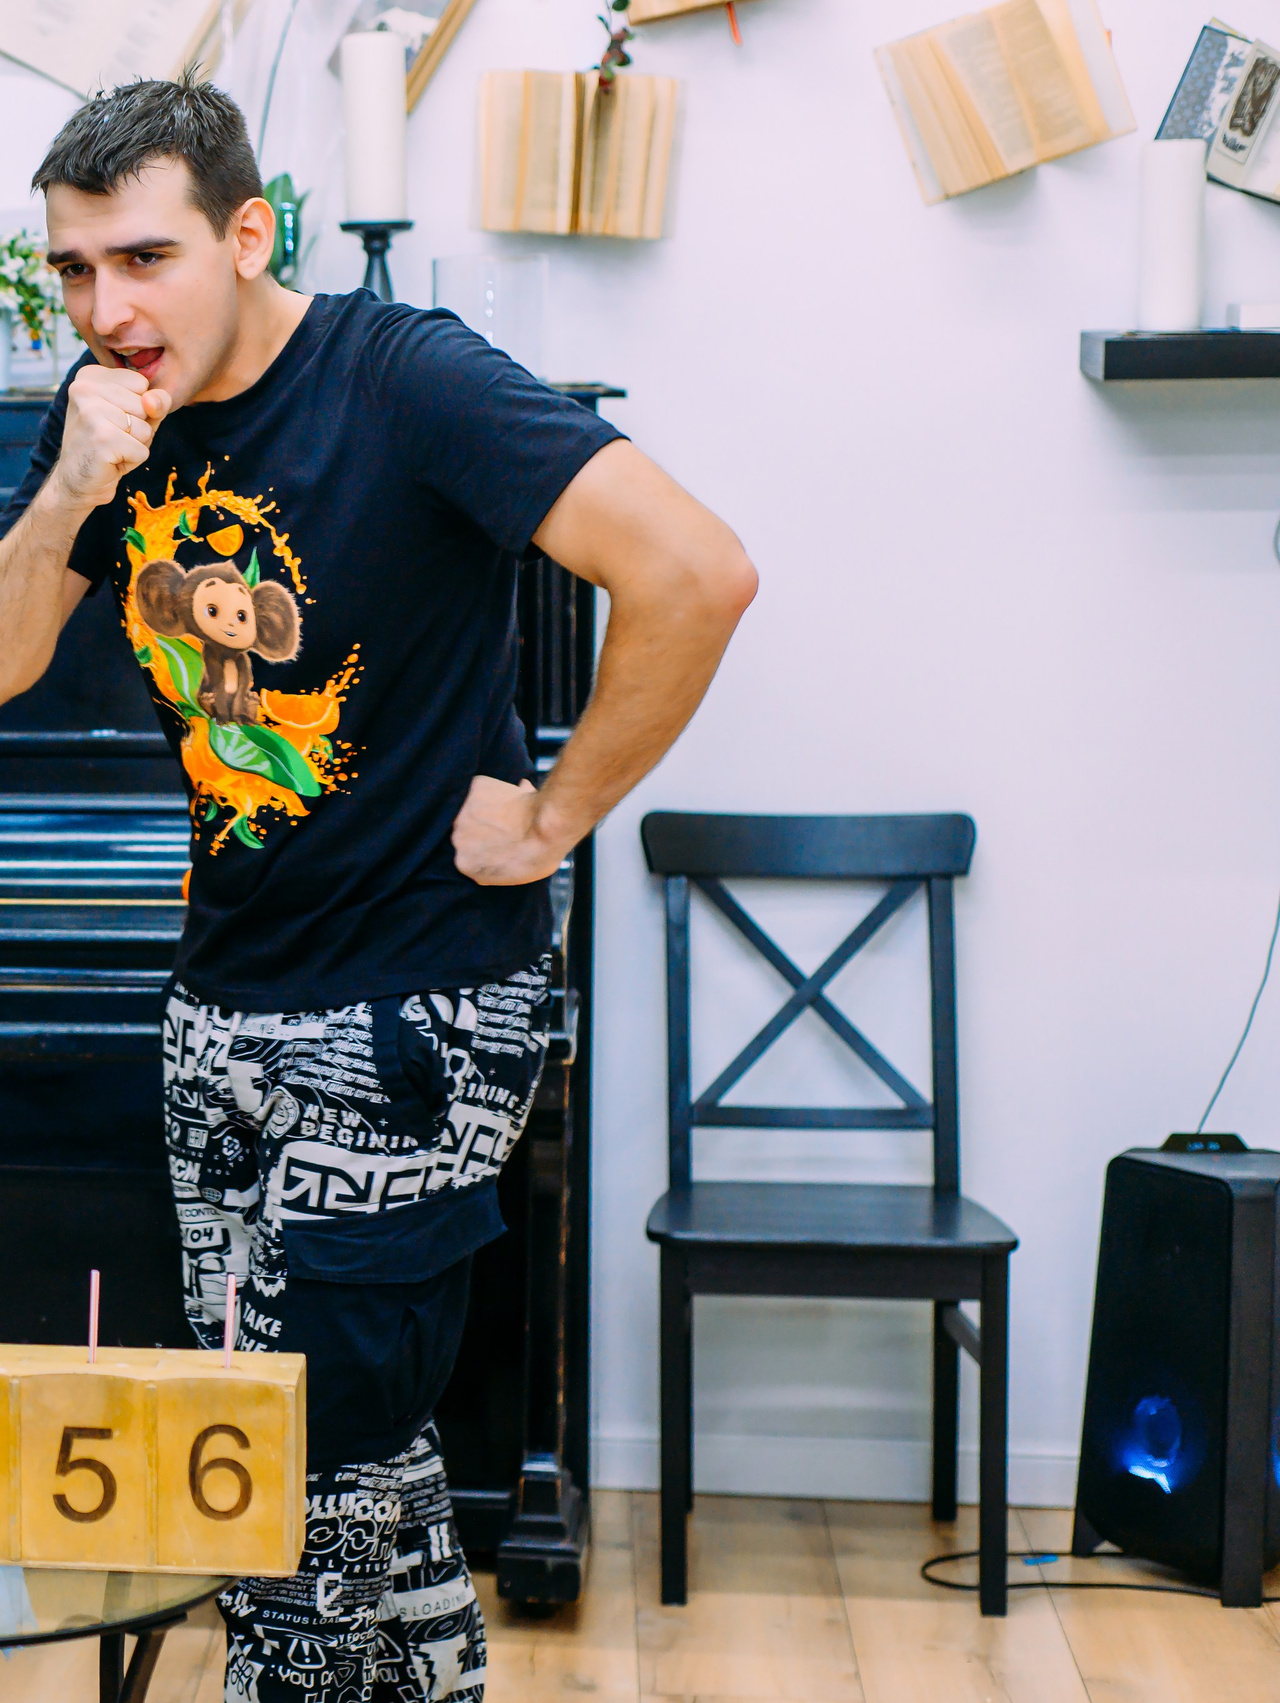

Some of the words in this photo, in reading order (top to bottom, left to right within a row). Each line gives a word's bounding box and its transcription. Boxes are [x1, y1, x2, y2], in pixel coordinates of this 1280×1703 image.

[303, 1103, 362, 1128] NEW
[242, 1302, 282, 1338] TAKE
[52, 1426, 117, 1523] 5
[188, 1423, 254, 1522] 6
[262, 1609, 310, 1625] STATUS
